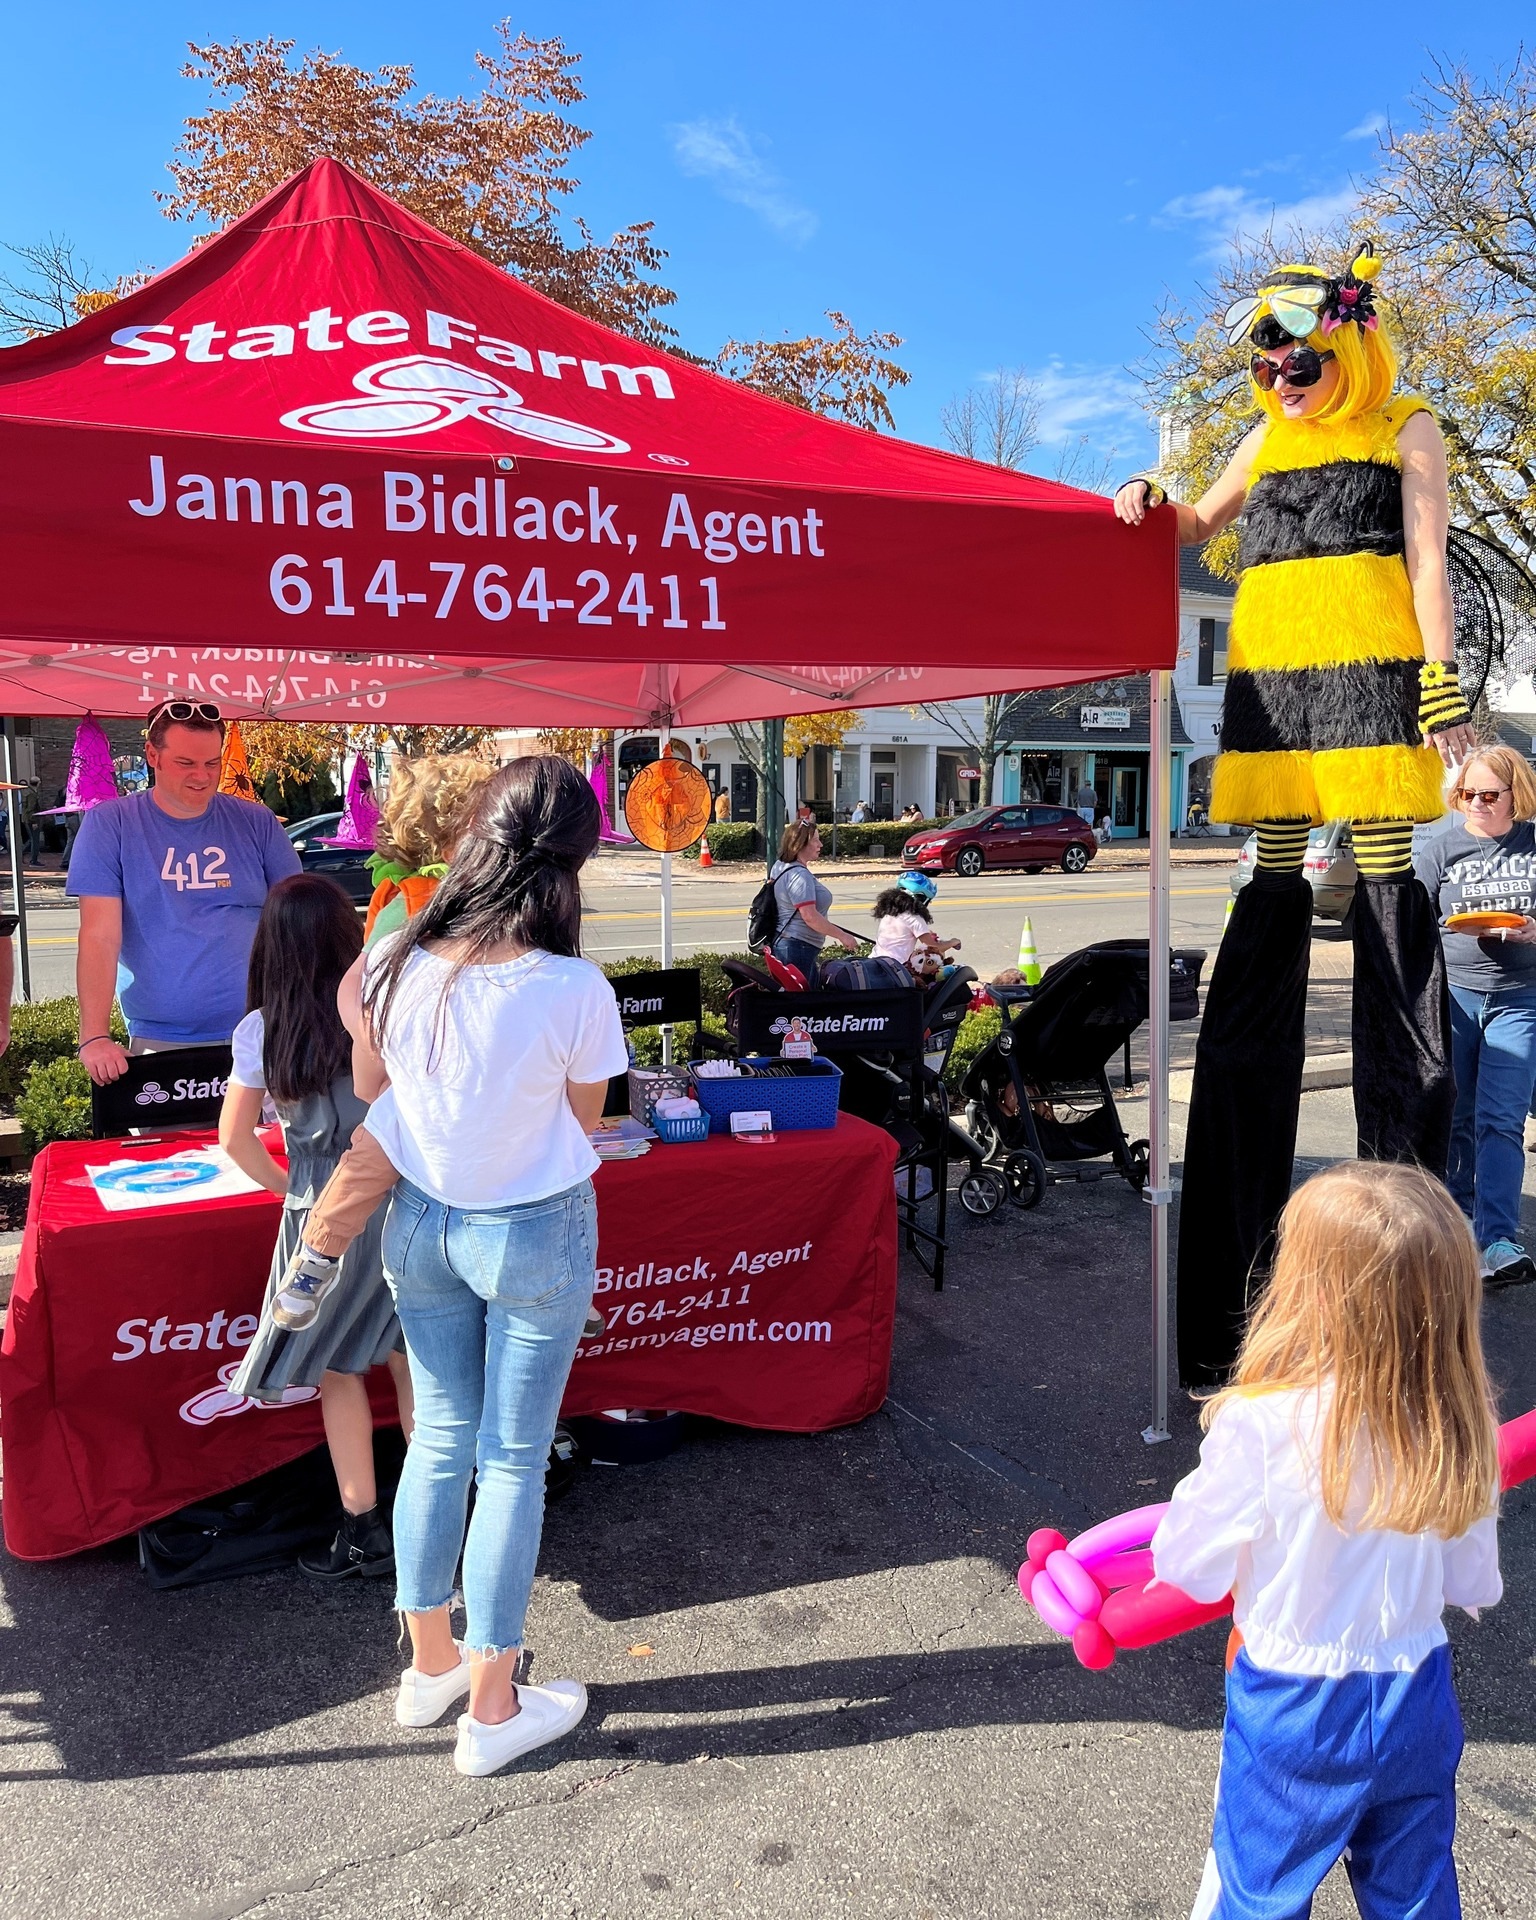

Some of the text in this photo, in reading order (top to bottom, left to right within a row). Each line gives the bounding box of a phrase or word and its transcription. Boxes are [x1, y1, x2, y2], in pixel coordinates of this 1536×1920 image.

[128, 455, 825, 563] Janna Bidlack, Agent
[269, 553, 726, 630] 614-764-2411
[892, 735, 908, 743] 661A
[959, 769, 977, 778] GRID
[161, 846, 230, 892] 412
[217, 880, 231, 888] PGH
[1450, 895, 1536, 915] FLORID
[593, 1240, 812, 1294] Bidlack, Agent
[112, 1309, 258, 1361] State
